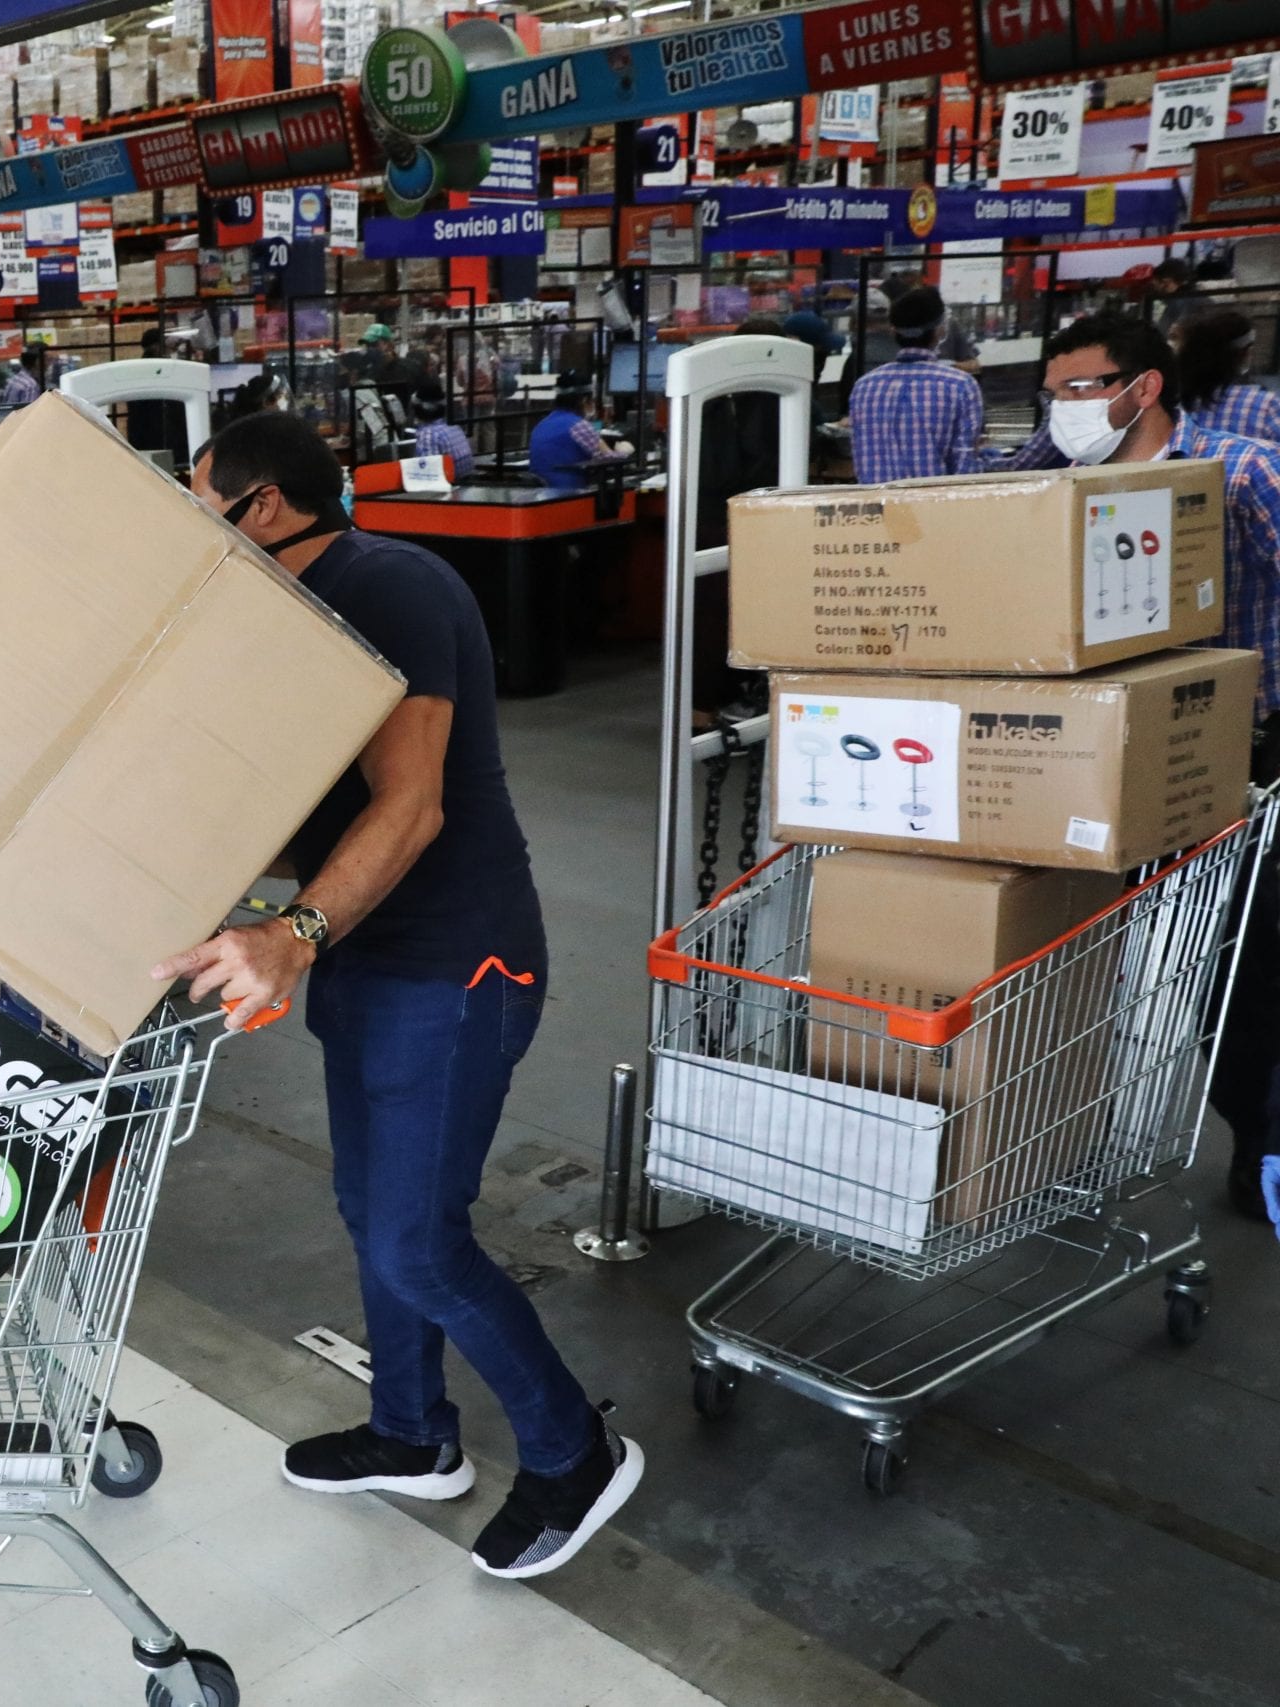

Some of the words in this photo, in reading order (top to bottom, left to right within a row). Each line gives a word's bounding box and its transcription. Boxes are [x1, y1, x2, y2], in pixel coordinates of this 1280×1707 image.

[839, 6, 920, 43] LUNES
[659, 19, 783, 69] Valoramos
[821, 53, 834, 75] A
[842, 26, 953, 71] VIERNES
[386, 56, 434, 102] 50
[667, 70, 694, 96] tu
[698, 43, 788, 86] lealtad
[501, 58, 579, 119] GANA
[391, 101, 439, 116] CLIENTES
[1159, 103, 1215, 132] 40%
[203, 106, 344, 167] GANADOR
[1011, 109, 1070, 139] 30%
[657, 135, 675, 163] 21
[235, 195, 253, 218] 19
[702, 199, 720, 227] 22
[433, 216, 496, 241] Servicio
[501, 213, 518, 234] al
[269, 245, 289, 267] 20
[813, 544, 850, 555] SILLA
[852, 543, 870, 555] DE
[873, 542, 901, 554] BAR
[813, 567, 862, 578] Alkosto
[864, 566, 891, 578] S.A.
[813, 586, 826, 597] PI
[813, 605, 851, 617] Model
[815, 625, 857, 636] Carton
[815, 643, 853, 655] Color:
[856, 643, 893, 655] ROJO
[968, 720, 1063, 742] tukasa
